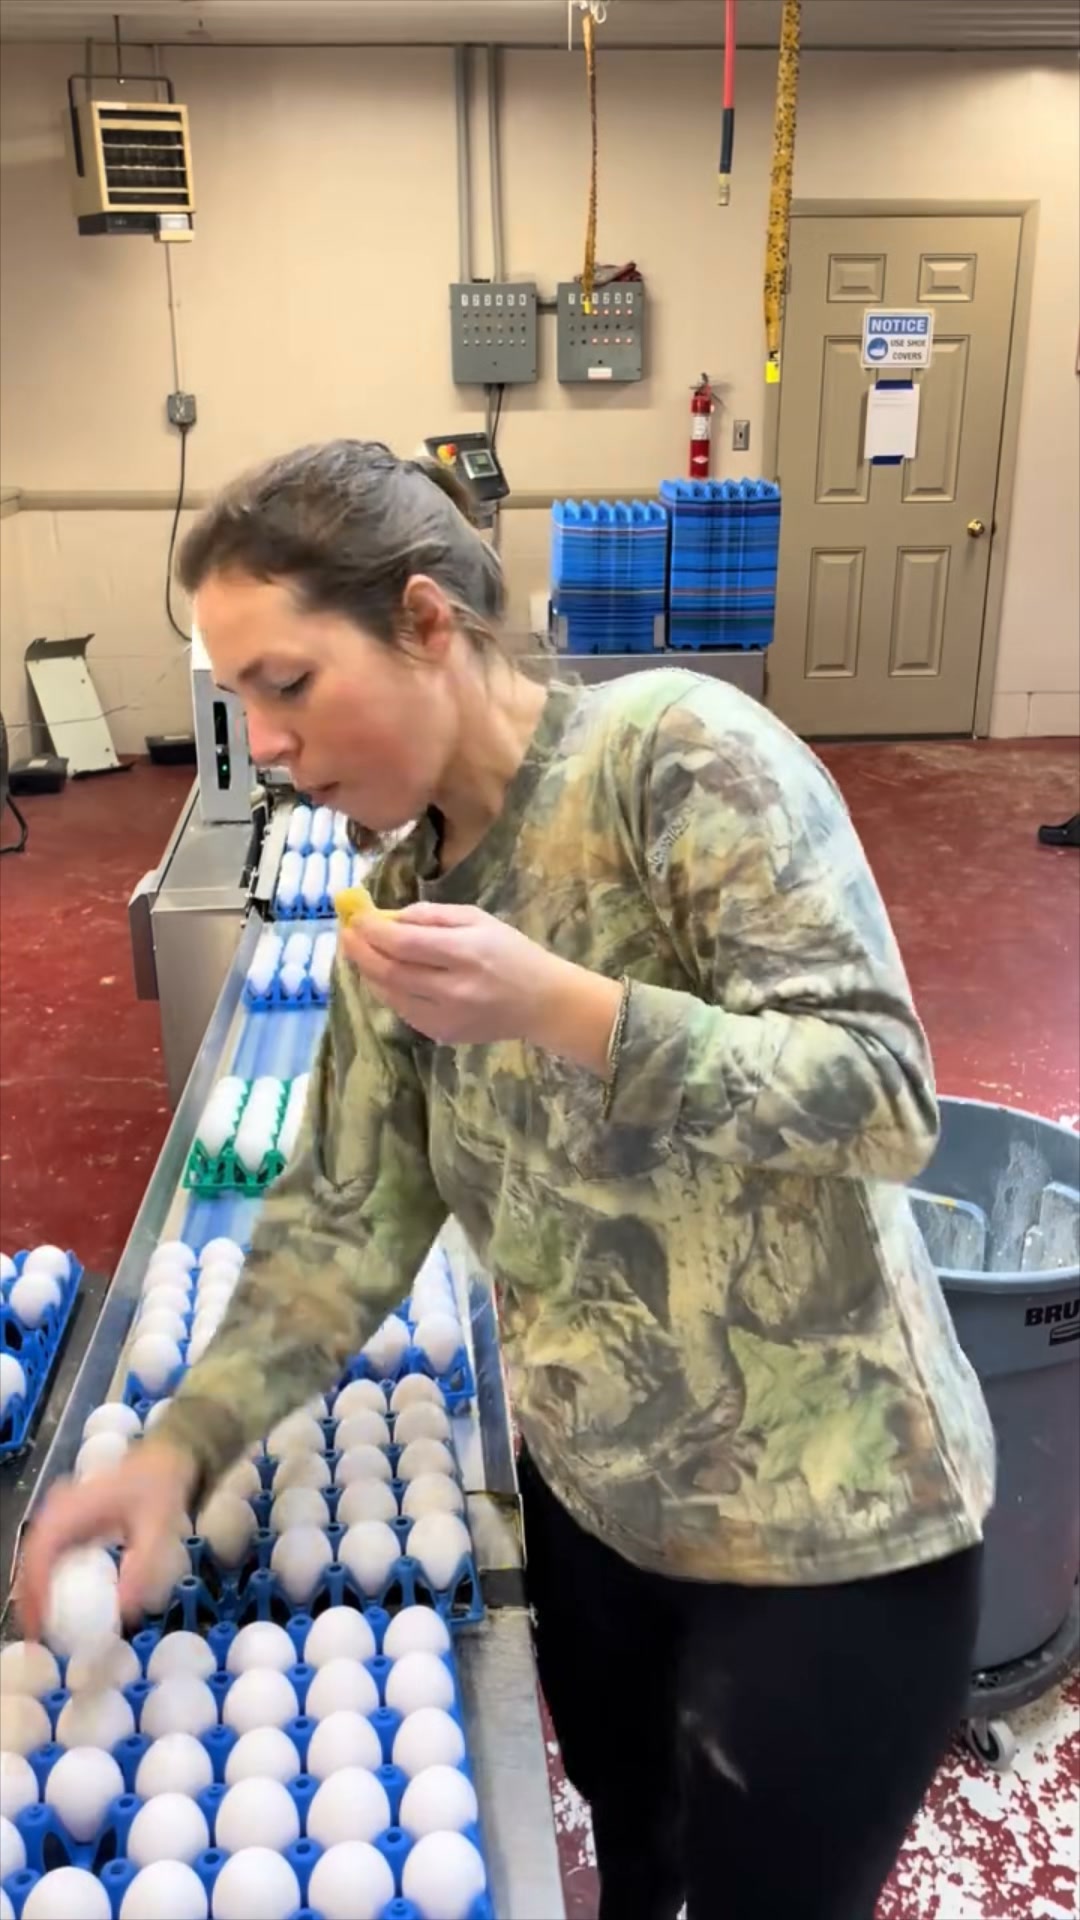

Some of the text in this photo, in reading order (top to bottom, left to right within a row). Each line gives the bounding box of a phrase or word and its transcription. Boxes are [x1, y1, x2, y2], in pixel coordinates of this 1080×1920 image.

[871, 319, 926, 332] NOTICE
[890, 339, 926, 347] USE SHOE
[892, 352, 922, 360] COVERS
